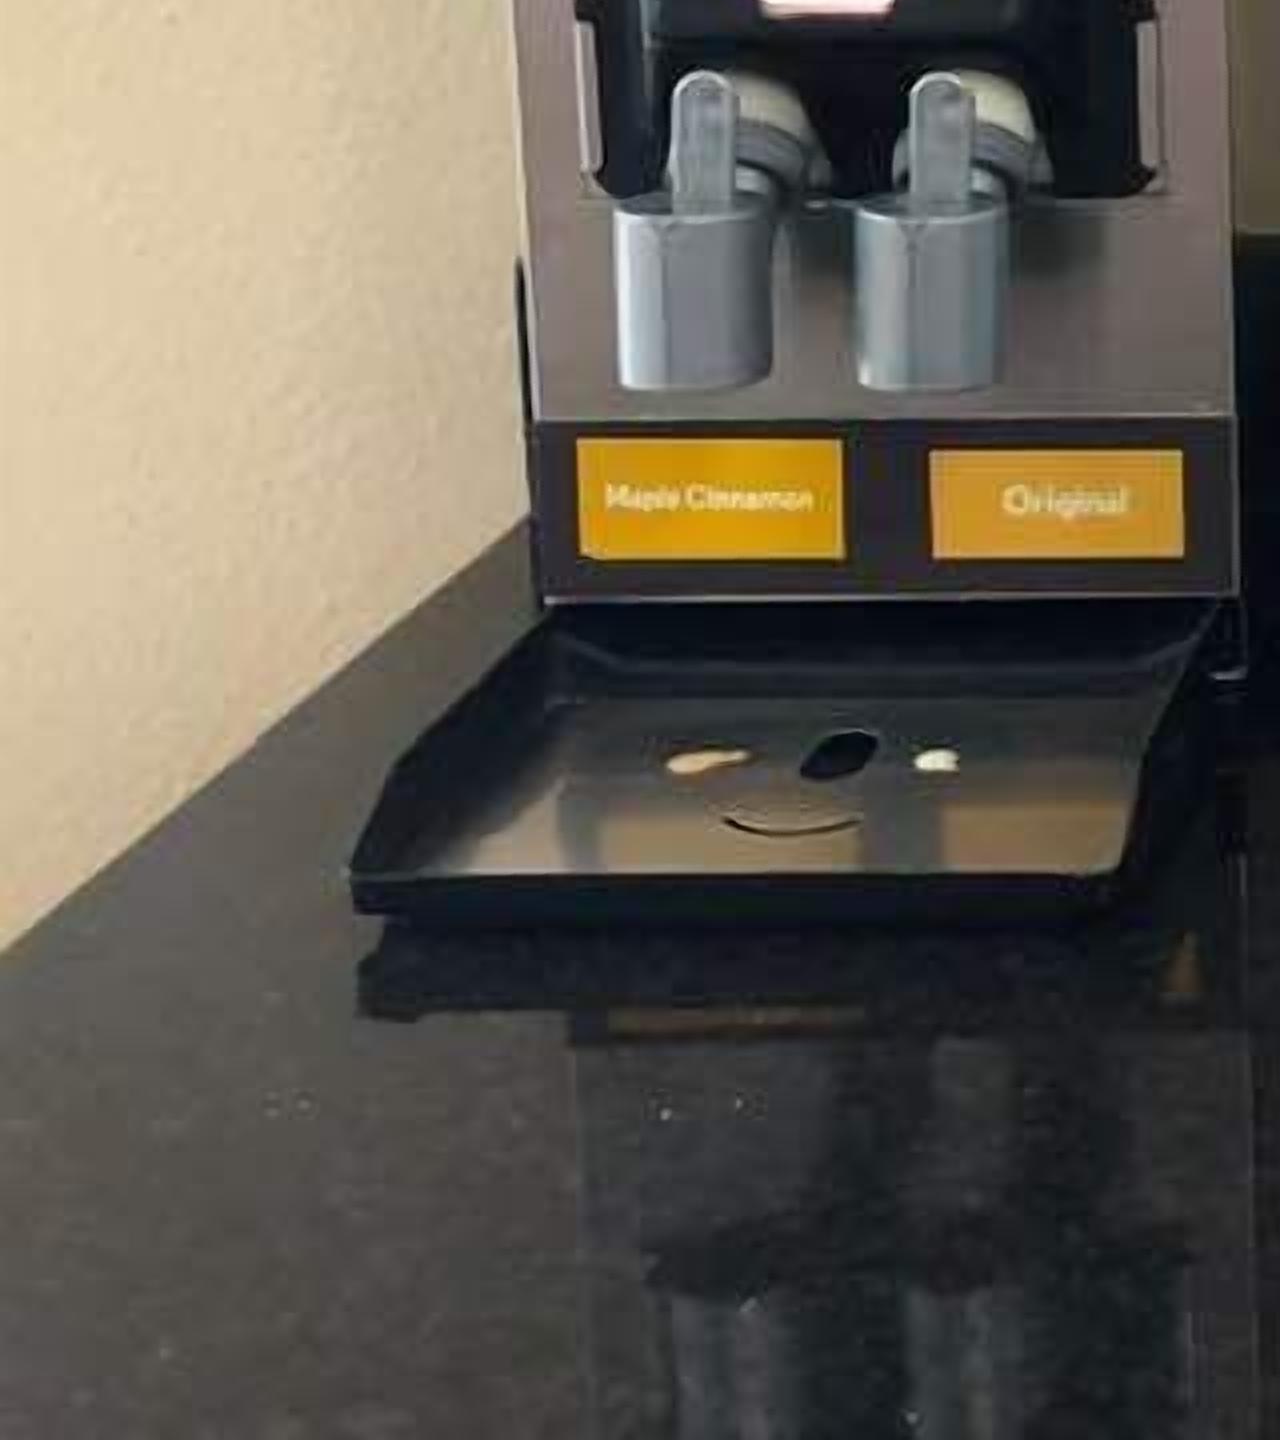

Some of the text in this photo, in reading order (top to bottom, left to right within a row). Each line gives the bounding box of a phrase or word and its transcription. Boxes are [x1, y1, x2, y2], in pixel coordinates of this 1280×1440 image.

[606, 482, 815, 512] Maple Cinnamon
[1001, 483, 1128, 521] Original
